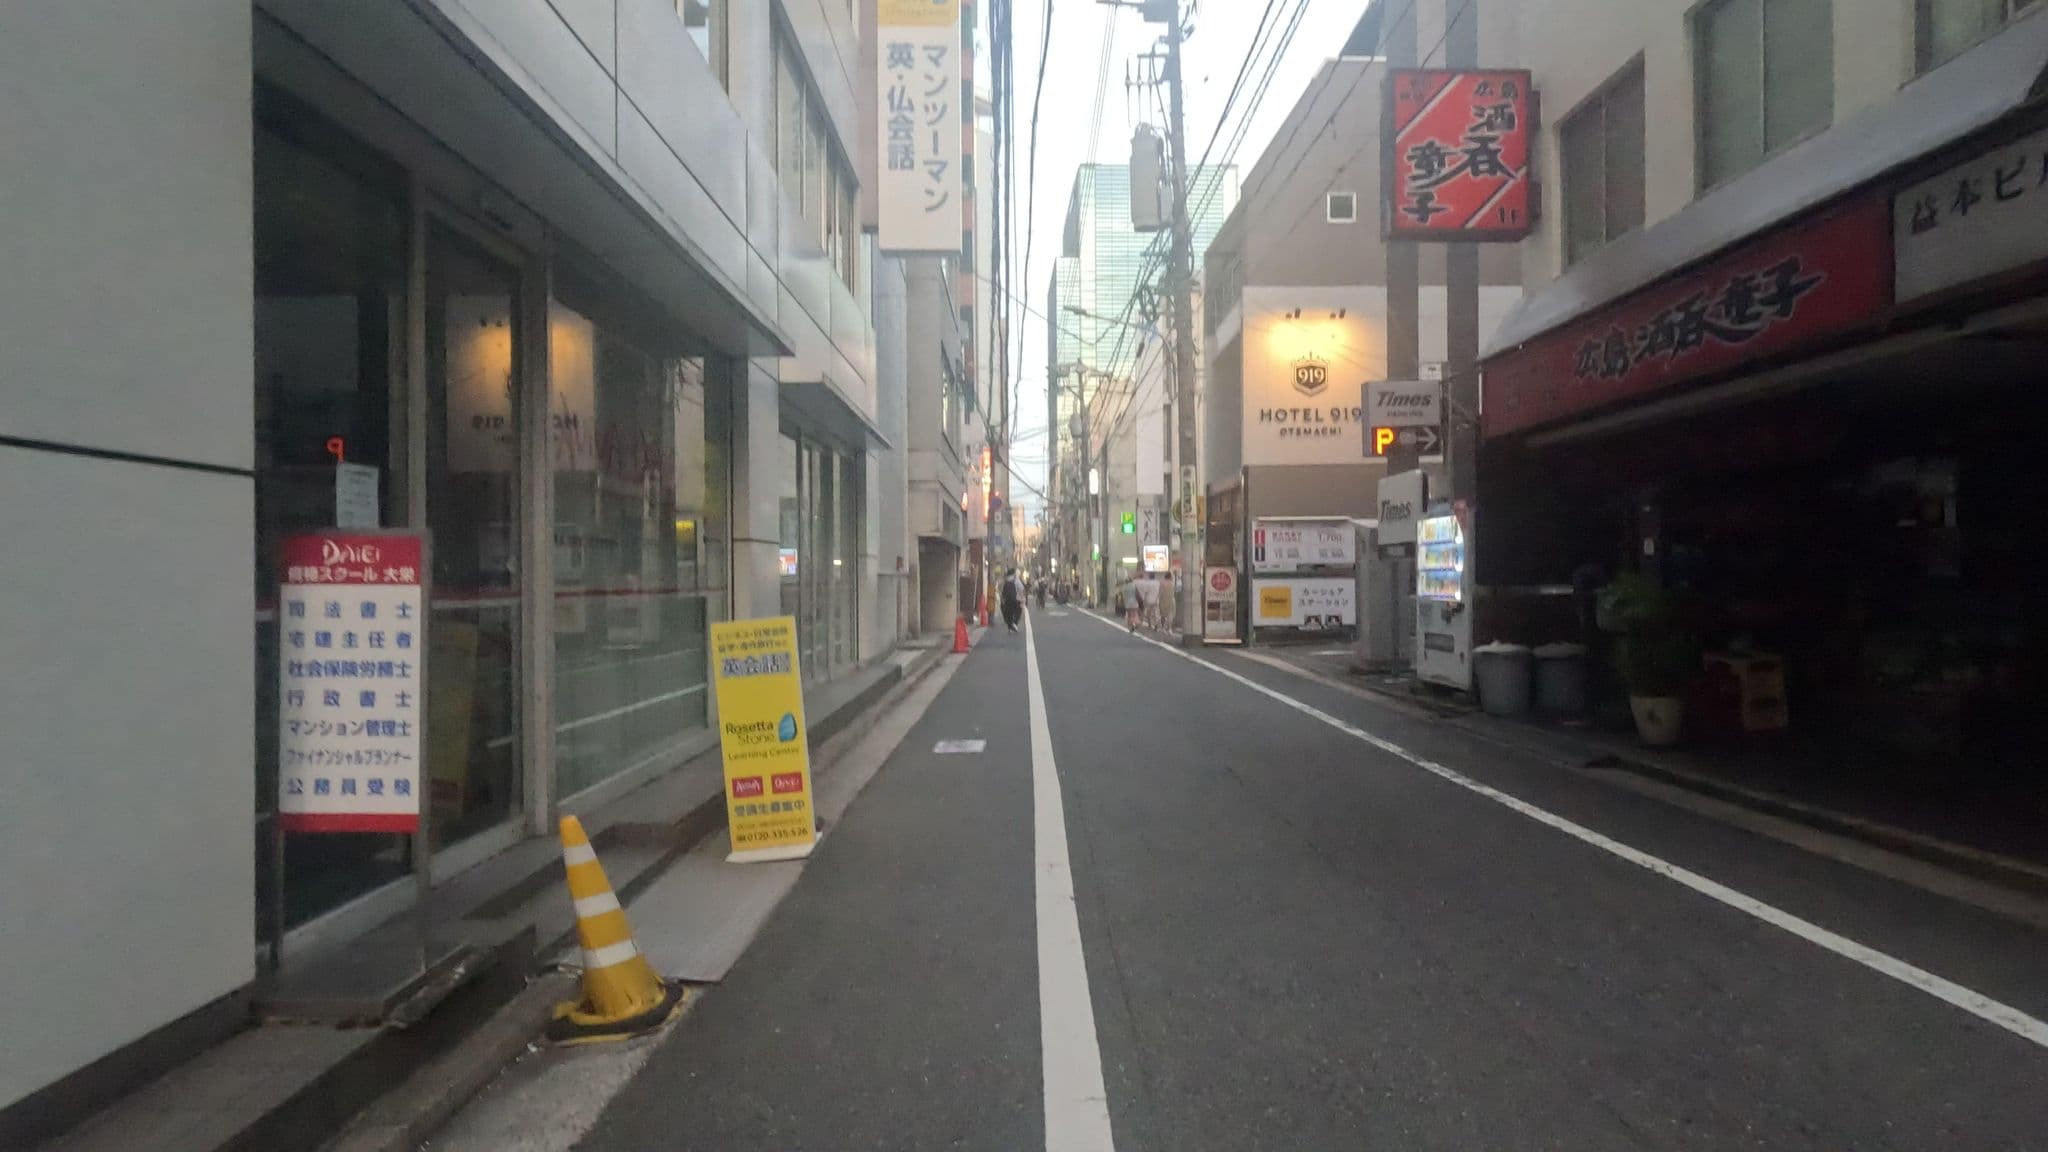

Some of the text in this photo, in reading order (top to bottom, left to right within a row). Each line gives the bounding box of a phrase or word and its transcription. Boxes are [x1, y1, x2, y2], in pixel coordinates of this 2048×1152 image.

[887, 42, 915, 170] 英・仏会話
[922, 45, 949, 213] マンツーマン
[1298, 367, 1325, 383] 919
[1378, 391, 1432, 407] Times
[1260, 407, 1362, 422] HOTEL 919
[1280, 427, 1341, 436] OTEMACHI
[1376, 428, 1394, 454] P
[288, 601, 413, 618] 司法書士
[288, 631, 412, 648] 宅建主任者
[288, 660, 412, 677] 社会保険労務士
[287, 690, 412, 707] 行政書士
[288, 719, 411, 736] マンション管理士
[726, 721, 774, 735] Rosetta
[737, 734, 775, 745] Stone
[287, 778, 411, 795] 公務員受験
